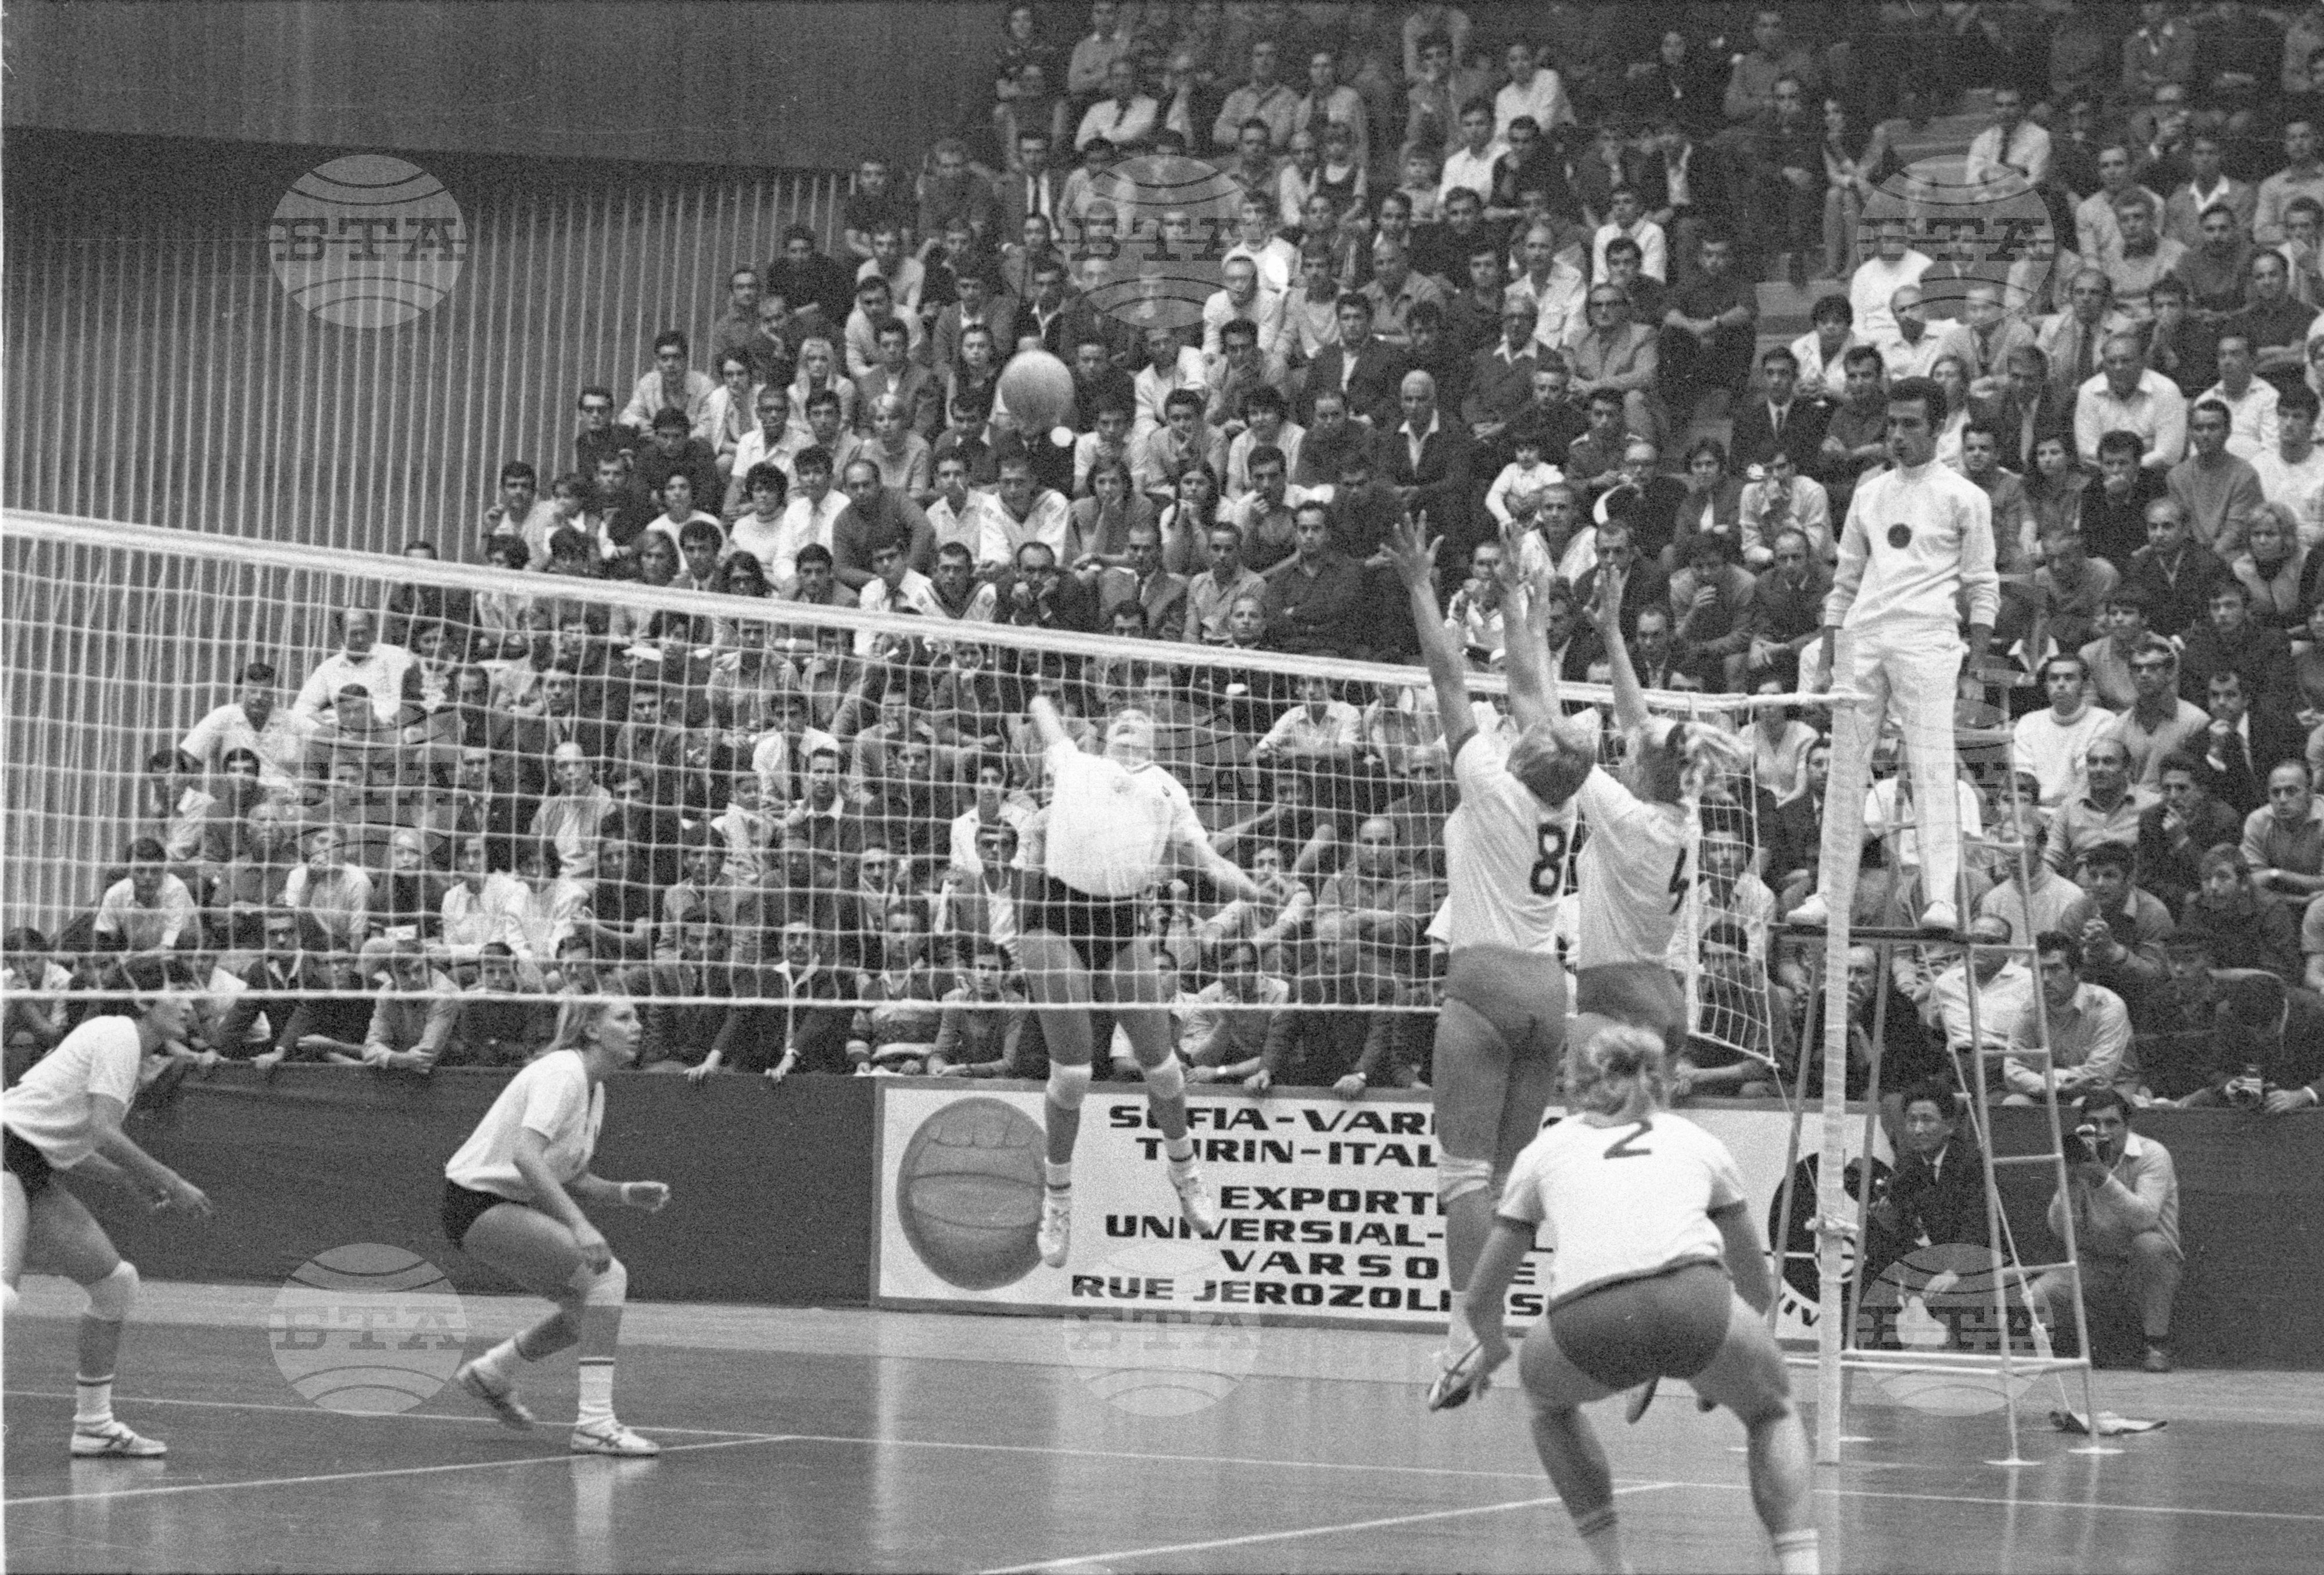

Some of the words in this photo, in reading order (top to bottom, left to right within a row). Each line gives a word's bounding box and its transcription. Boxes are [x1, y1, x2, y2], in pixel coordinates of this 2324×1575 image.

[1530, 822, 1566, 896] 8
[1109, 1105, 1435, 1135] SFIA-VAR
[1135, 1137, 1437, 1168] TRIN-ITAL
[1603, 1117, 1654, 1159] 2
[1071, 1275, 1174, 1301] RUE
